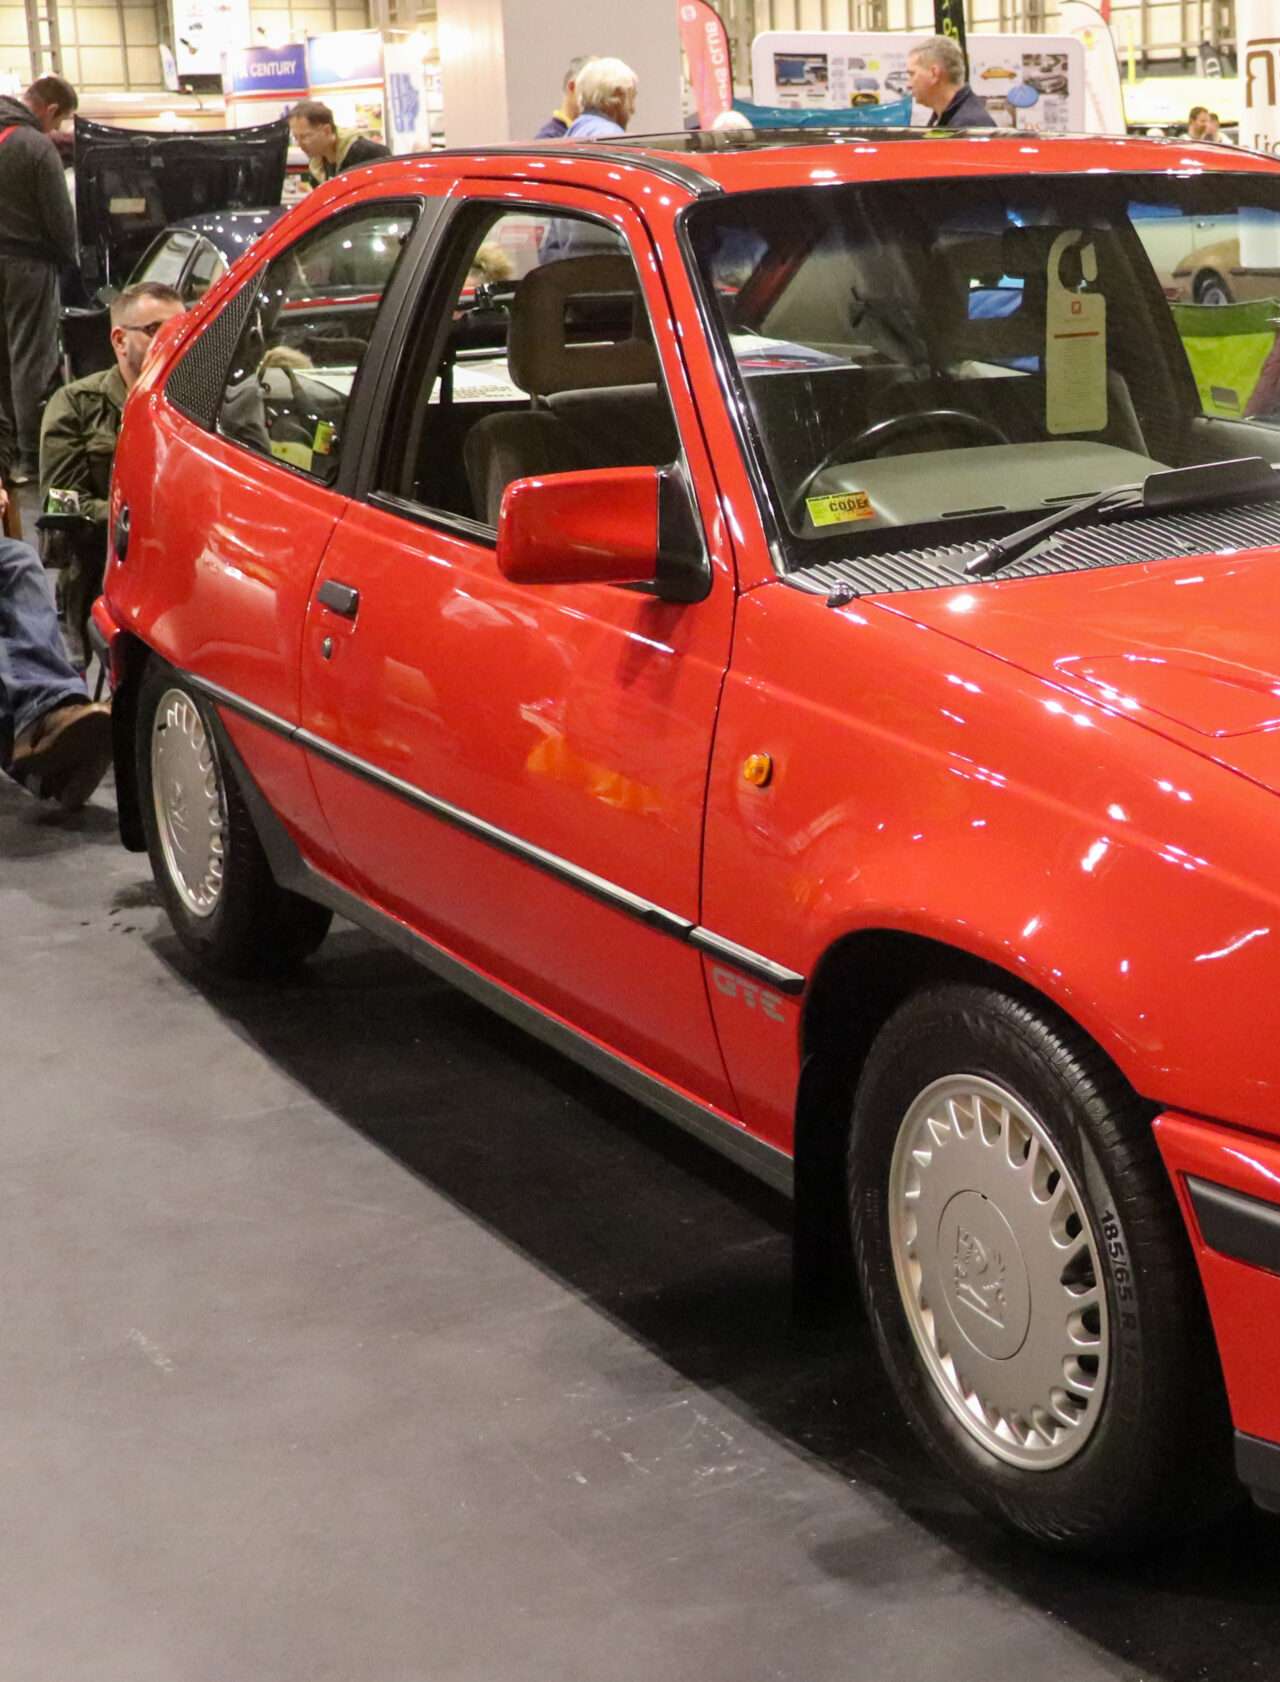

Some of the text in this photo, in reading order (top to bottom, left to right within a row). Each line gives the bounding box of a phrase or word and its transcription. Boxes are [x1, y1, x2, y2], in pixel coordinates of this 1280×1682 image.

[250, 60, 297, 77] CENTURY
[713, 966, 784, 1022] GTE
[1101, 1209, 1133, 1301] 185/65
